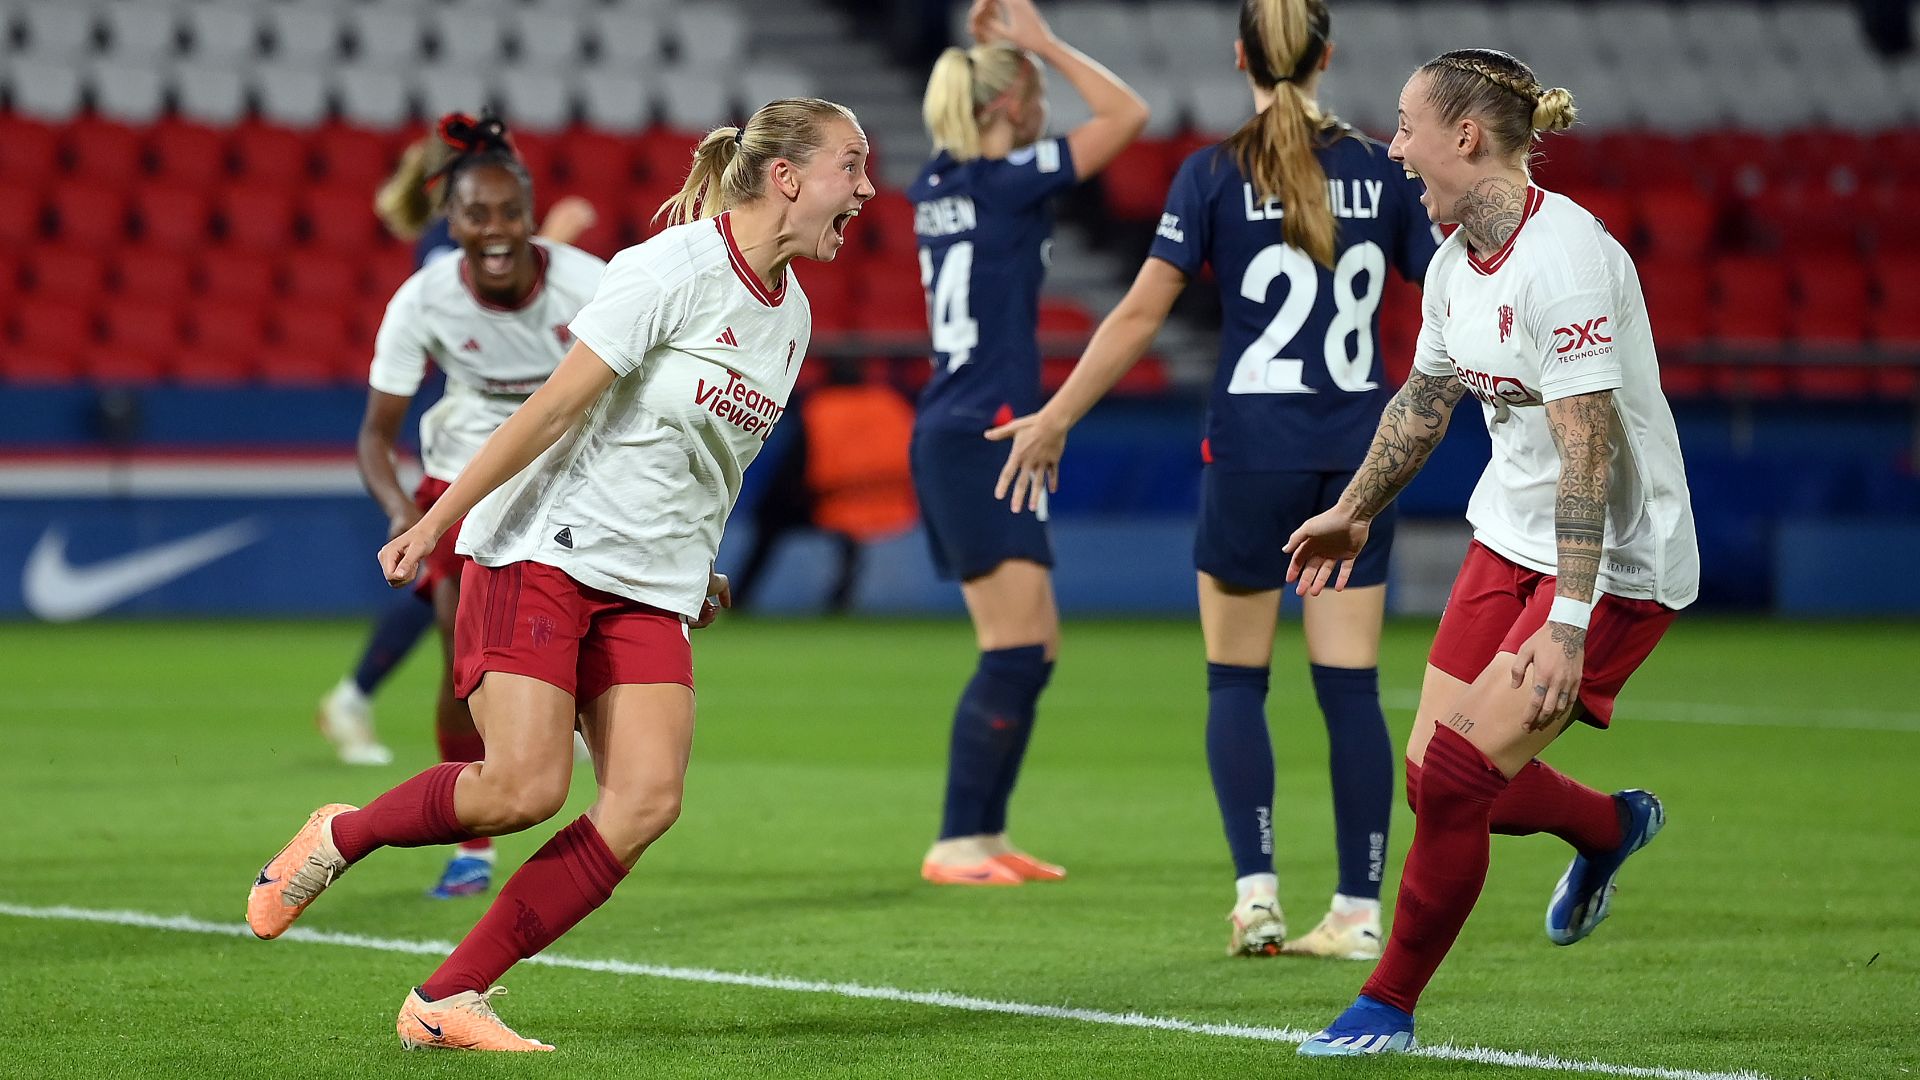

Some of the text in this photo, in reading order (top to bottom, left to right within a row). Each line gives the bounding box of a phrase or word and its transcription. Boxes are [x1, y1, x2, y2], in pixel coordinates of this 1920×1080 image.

[1227, 240, 1386, 394] 28
[1553, 316, 1612, 353] DXC
[1558, 346, 1614, 363] TECHNOLOGY
[695, 378, 768, 436] Viewer
[725, 368, 776, 420] Team
[1449, 712, 1475, 734] 11:11
[1256, 806, 1272, 855] PARIS
[1368, 831, 1384, 882] PARIS
